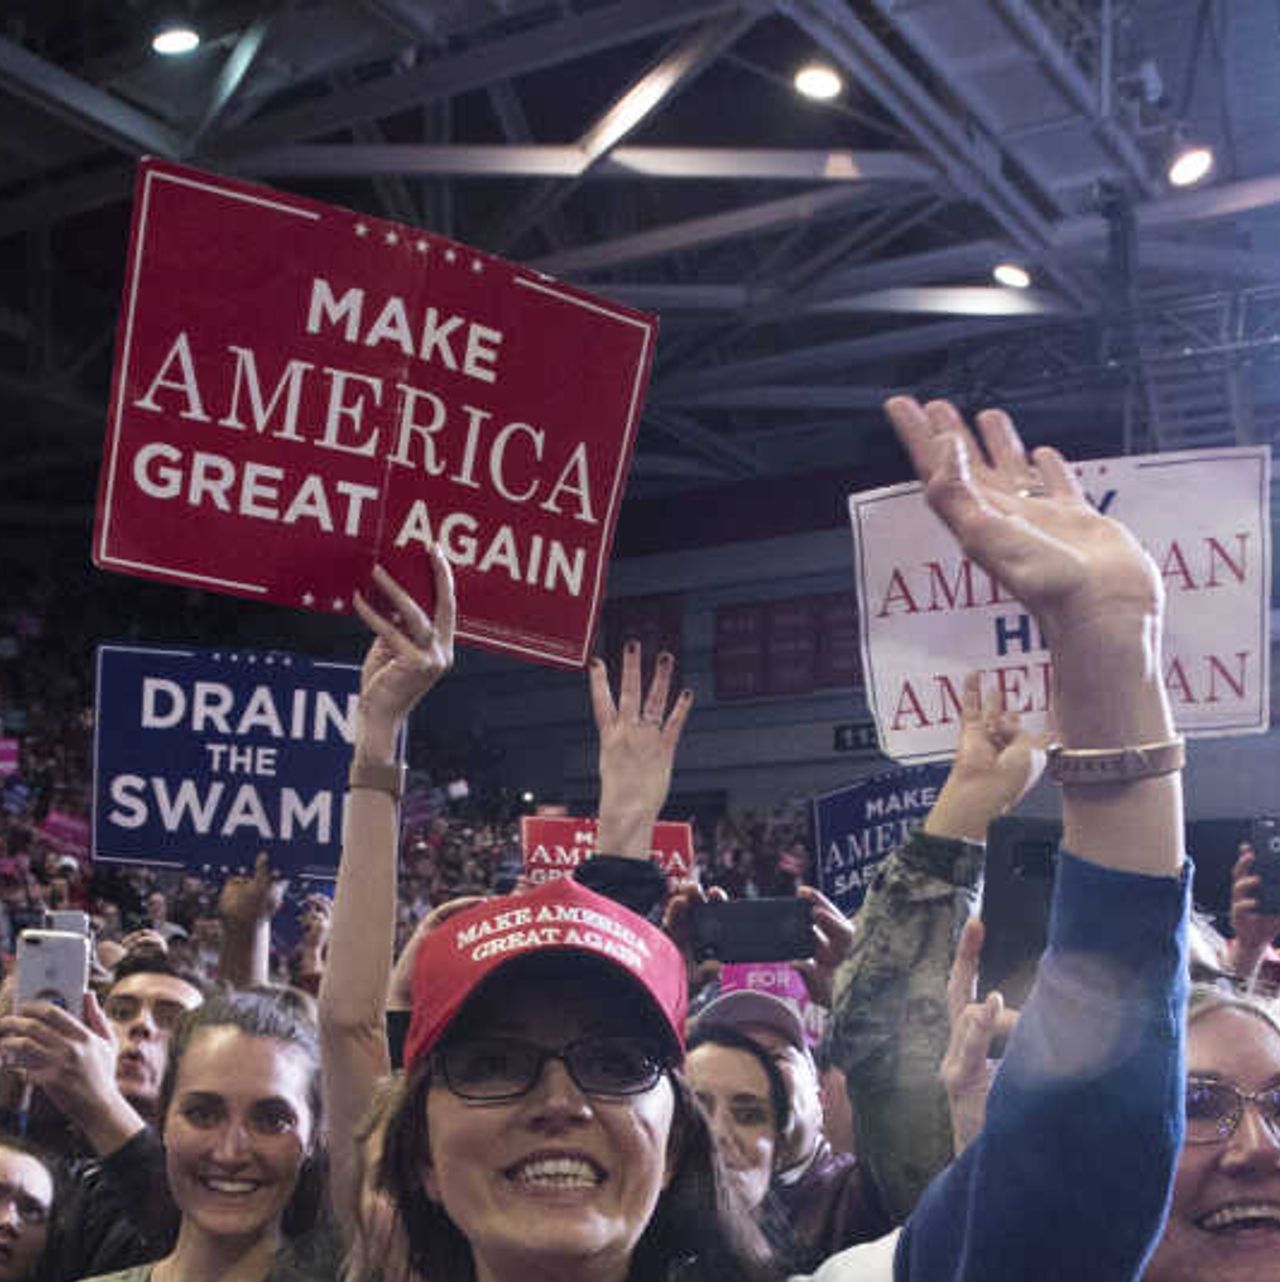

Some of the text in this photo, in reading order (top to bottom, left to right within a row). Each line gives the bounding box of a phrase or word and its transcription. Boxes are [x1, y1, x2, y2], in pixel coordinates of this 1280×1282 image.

[306, 278, 504, 384] MAKE
[134, 332, 606, 525] AMERICA
[133, 442, 587, 598] GREAT AGAIN
[140, 676, 360, 746] DRAIN
[206, 743, 278, 777] THE
[109, 775, 350, 845] SWAM
[864, 787, 938, 821] MAKE
[457, 906, 532, 949] MAKE
[471, 928, 562, 961] GREAT
